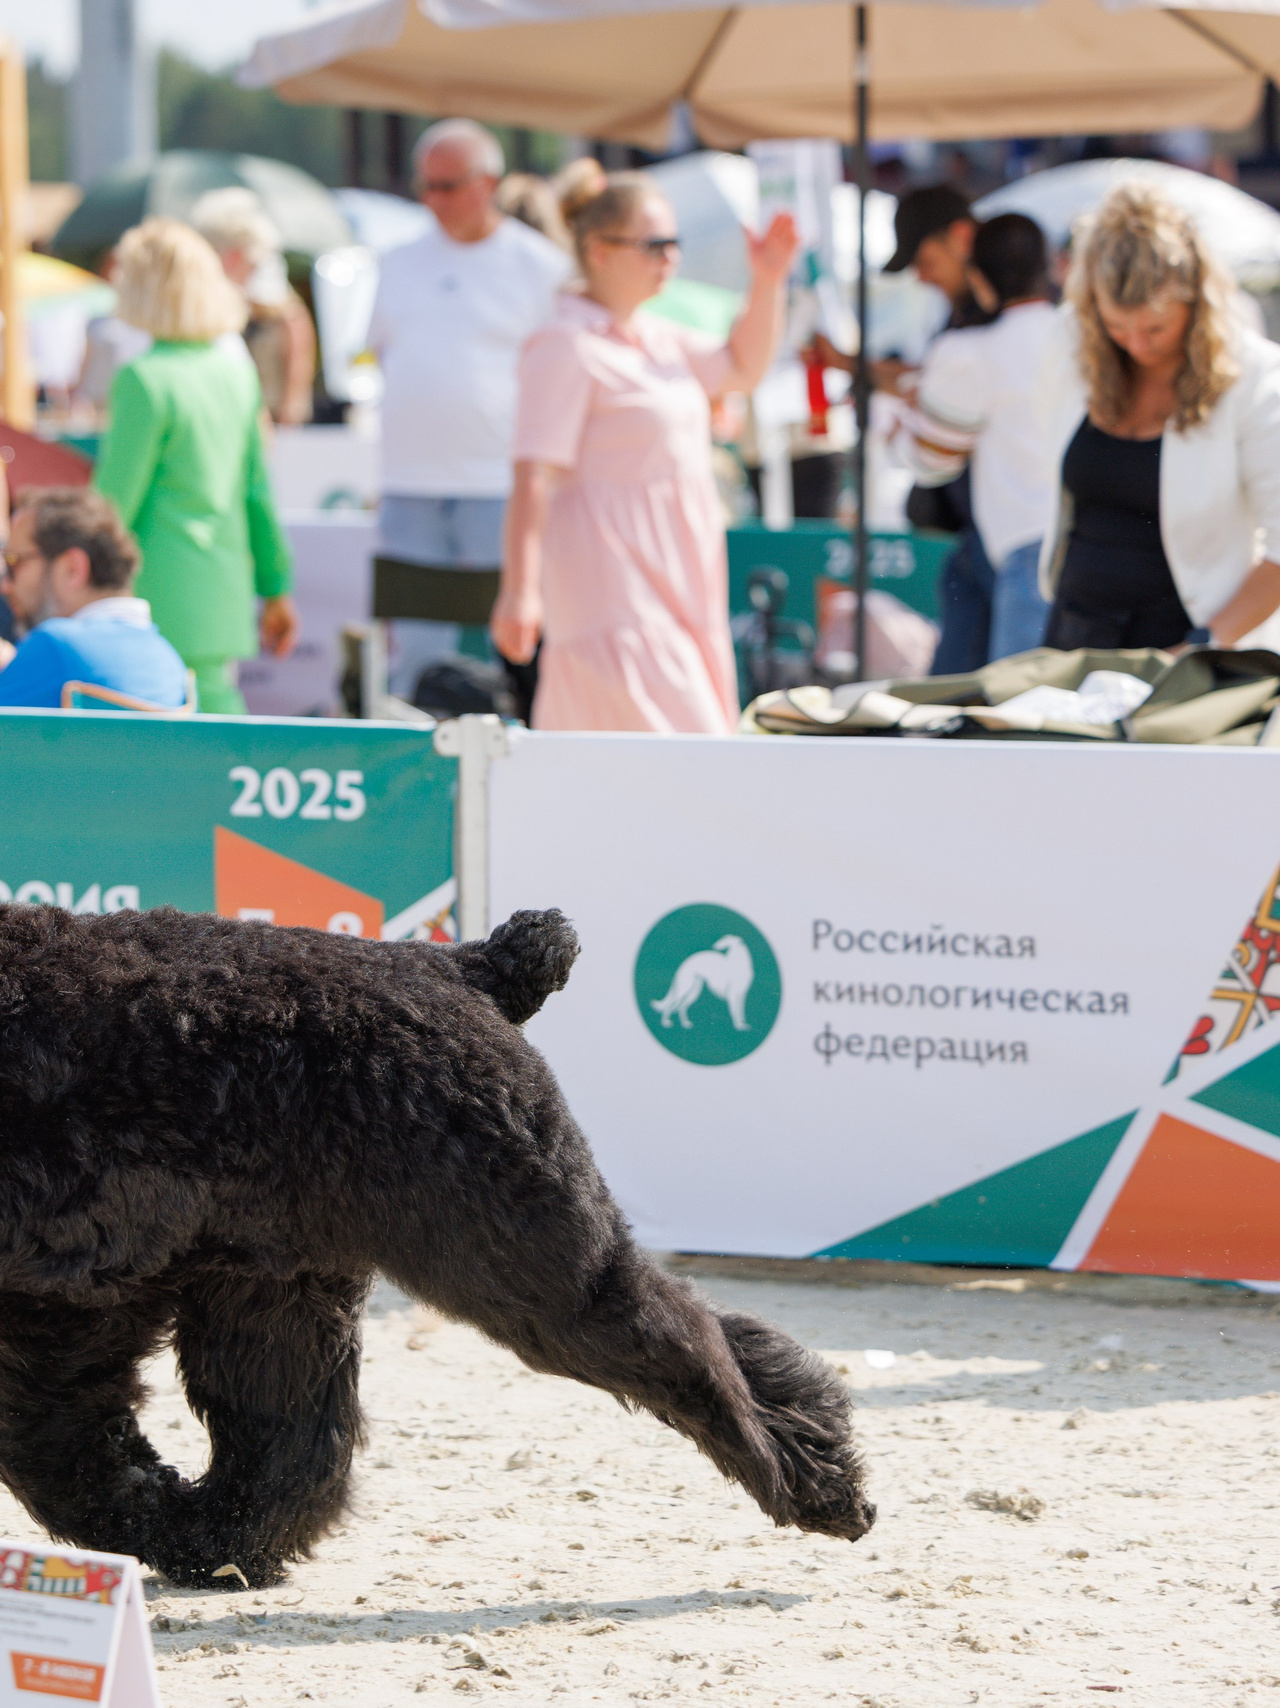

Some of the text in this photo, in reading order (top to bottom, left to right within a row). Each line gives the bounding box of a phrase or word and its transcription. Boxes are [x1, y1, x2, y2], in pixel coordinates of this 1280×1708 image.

[824, 539, 916, 578] 225
[229, 765, 366, 821] 2025
[812, 917, 1037, 959] Российская
[812, 978, 1130, 1016] кинологическая
[812, 1021, 1030, 1069] федерация
